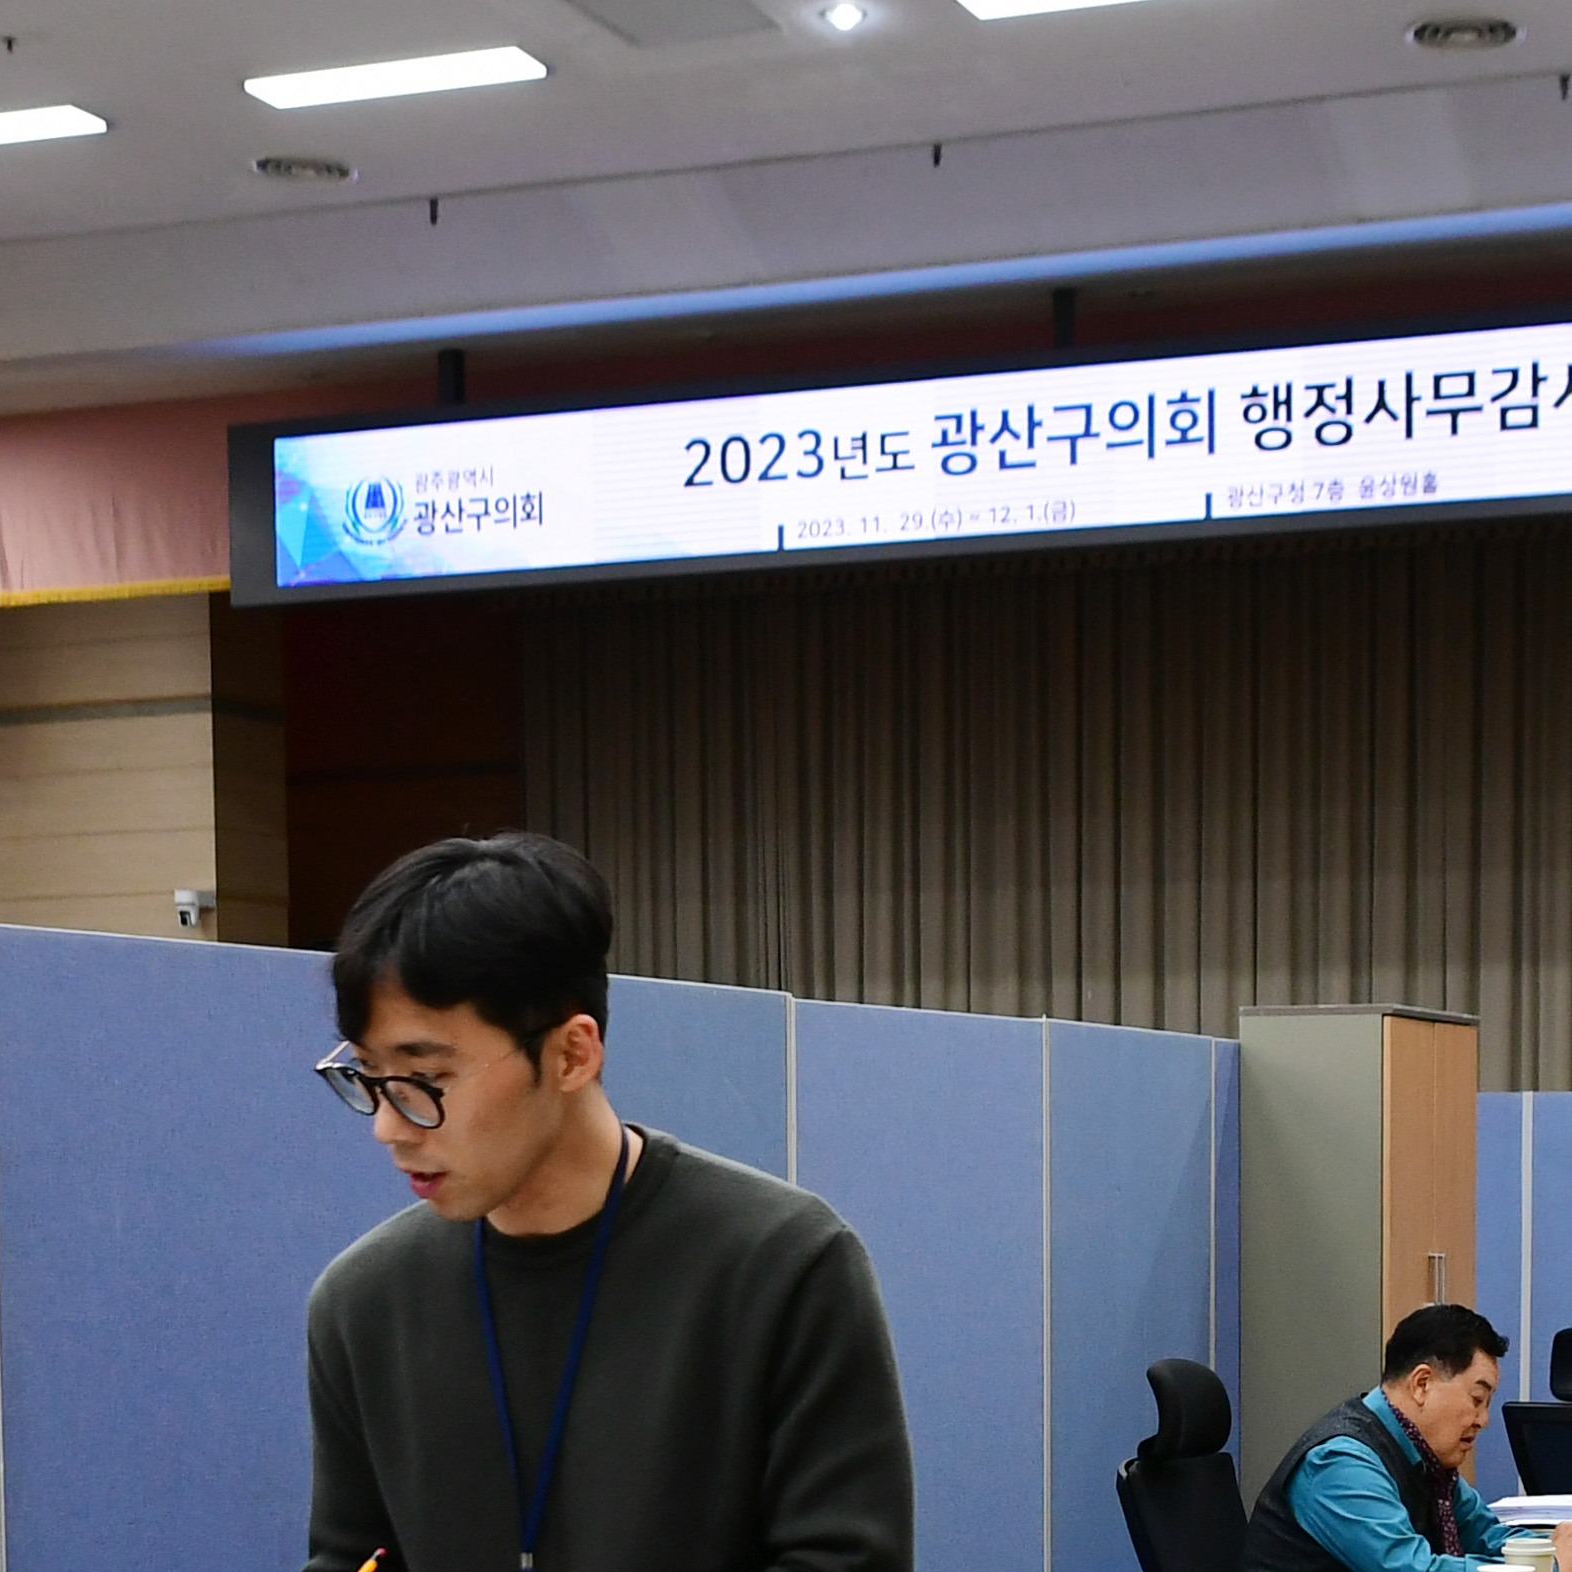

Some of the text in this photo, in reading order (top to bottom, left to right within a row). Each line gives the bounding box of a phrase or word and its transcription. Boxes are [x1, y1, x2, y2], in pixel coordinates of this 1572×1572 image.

[683, 428, 915, 487] 2023년도
[932, 388, 1216, 475] 광산구의회
[415, 465, 494, 494] 광주광역시
[1228, 470, 1438, 508] 광산구청 7층 윤상원홀
[414, 490, 543, 536] 광산구의회
[797, 519, 851, 539] 2023.
